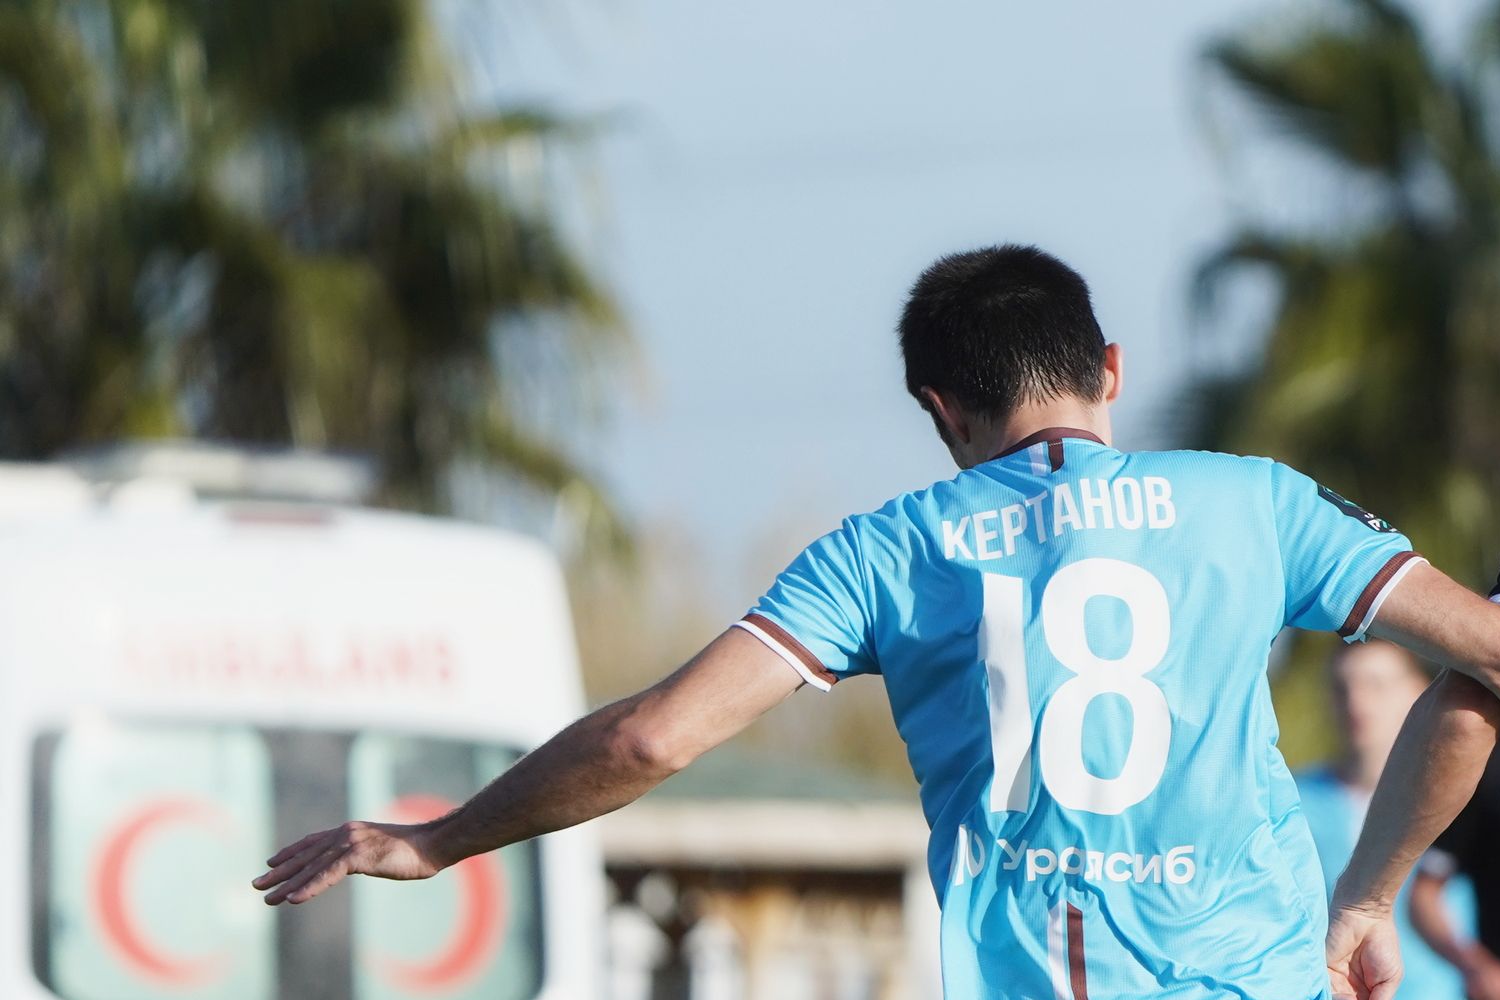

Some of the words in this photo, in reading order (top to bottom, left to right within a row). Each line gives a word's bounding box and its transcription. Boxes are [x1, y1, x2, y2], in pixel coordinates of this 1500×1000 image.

[942, 476, 1176, 560] КЕРТАНОВ
[977, 558, 1172, 816] 18
[996, 838, 1196, 884] Уралсиб
